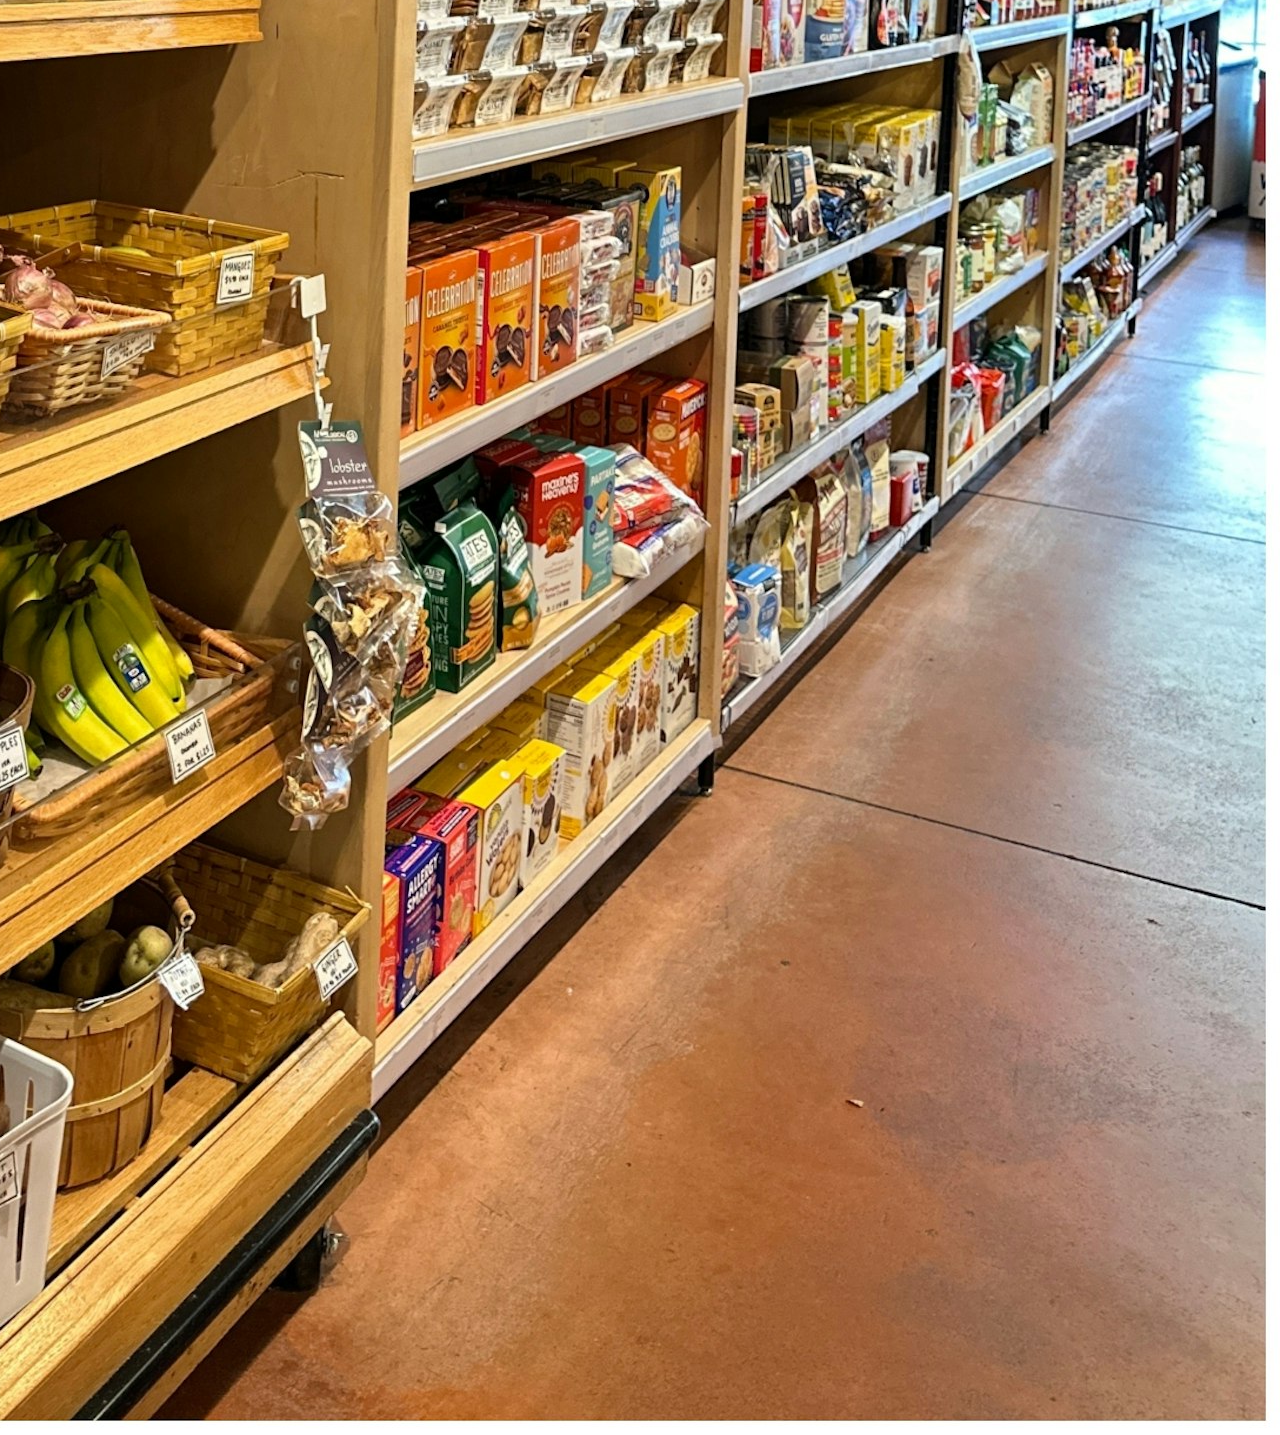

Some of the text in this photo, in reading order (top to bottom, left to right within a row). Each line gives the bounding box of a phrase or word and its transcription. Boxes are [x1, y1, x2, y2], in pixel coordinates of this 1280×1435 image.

[491, 257, 533, 299] CELEBRATION
[426, 275, 476, 319] CELEBRATION
[328, 457, 368, 474] lobster
[326, 475, 373, 486] mushrooms
[171, 718, 203, 745] BANANAS
[8, 763, 25, 778] EACH
[407, 852, 441, 898] ALLERGY
[321, 948, 342, 974] GINGER
